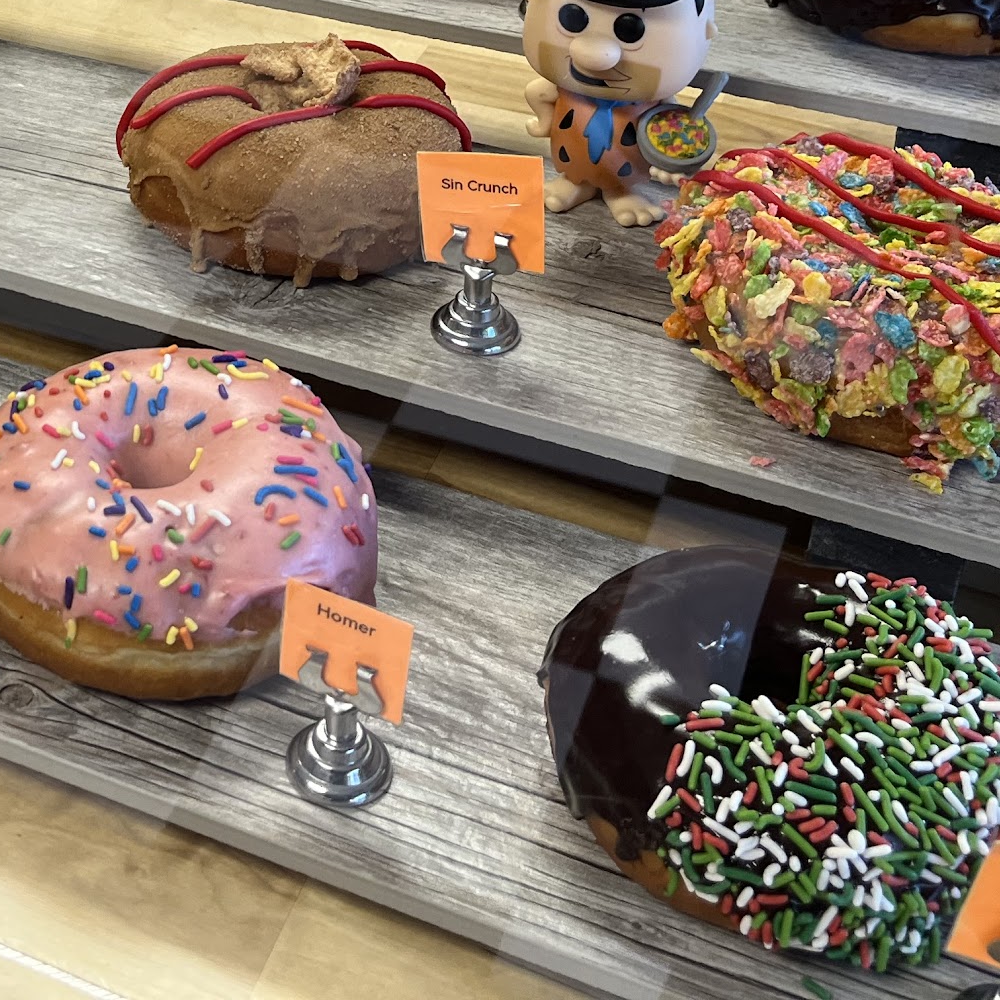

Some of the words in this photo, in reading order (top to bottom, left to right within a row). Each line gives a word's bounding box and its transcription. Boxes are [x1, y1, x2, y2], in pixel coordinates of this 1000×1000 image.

[441, 178, 463, 190] Sin
[467, 180, 518, 195] Crunch
[317, 603, 377, 636] Homer
